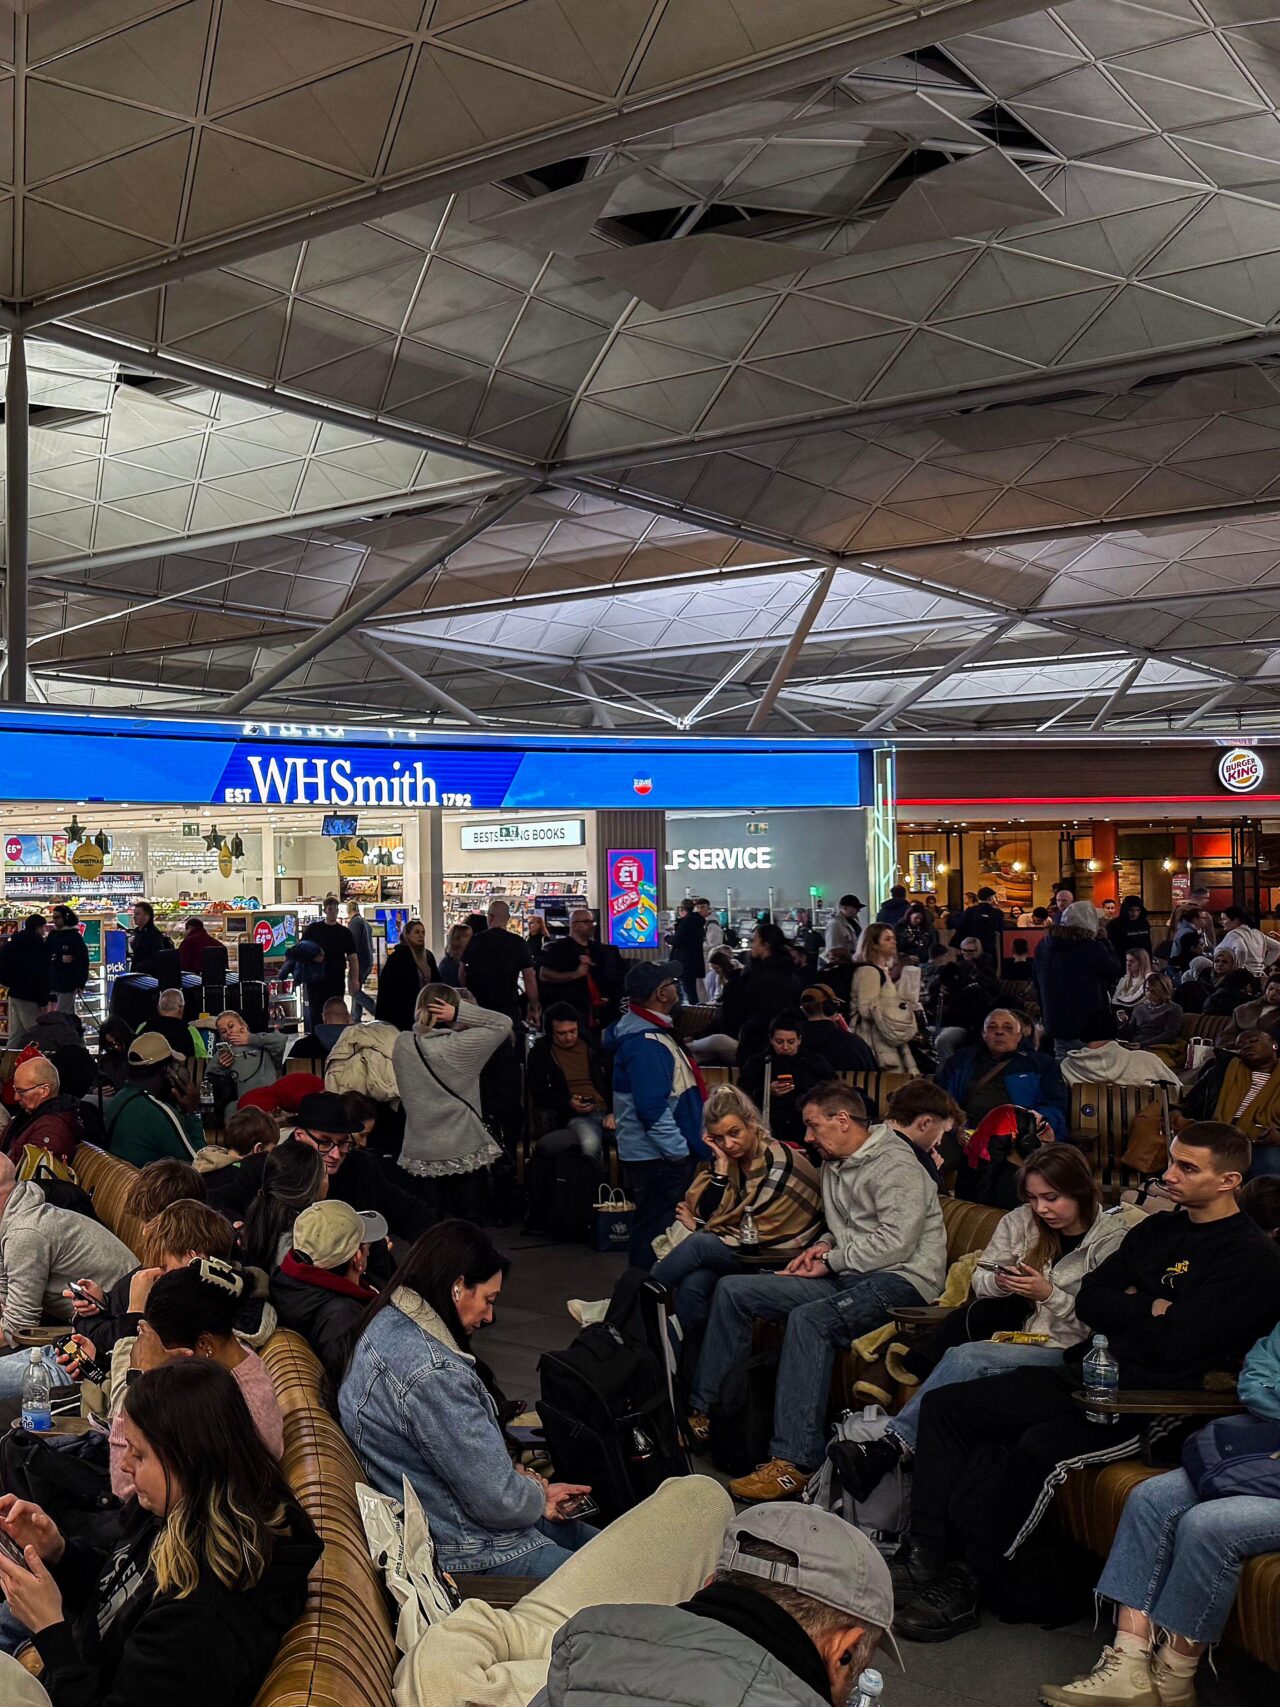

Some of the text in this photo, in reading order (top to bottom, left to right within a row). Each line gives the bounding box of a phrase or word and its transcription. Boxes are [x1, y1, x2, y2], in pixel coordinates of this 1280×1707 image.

[1226, 758, 1255, 773] BURGER
[1227, 764, 1258, 782] KING
[225, 756, 472, 807] EST WHSmith 1792
[634, 778, 652, 786] travel
[533, 828, 565, 840] BOOKS
[688, 847, 772, 869] SERVICE
[619, 866, 638, 882] £1
[107, 963, 124, 973] Pick
